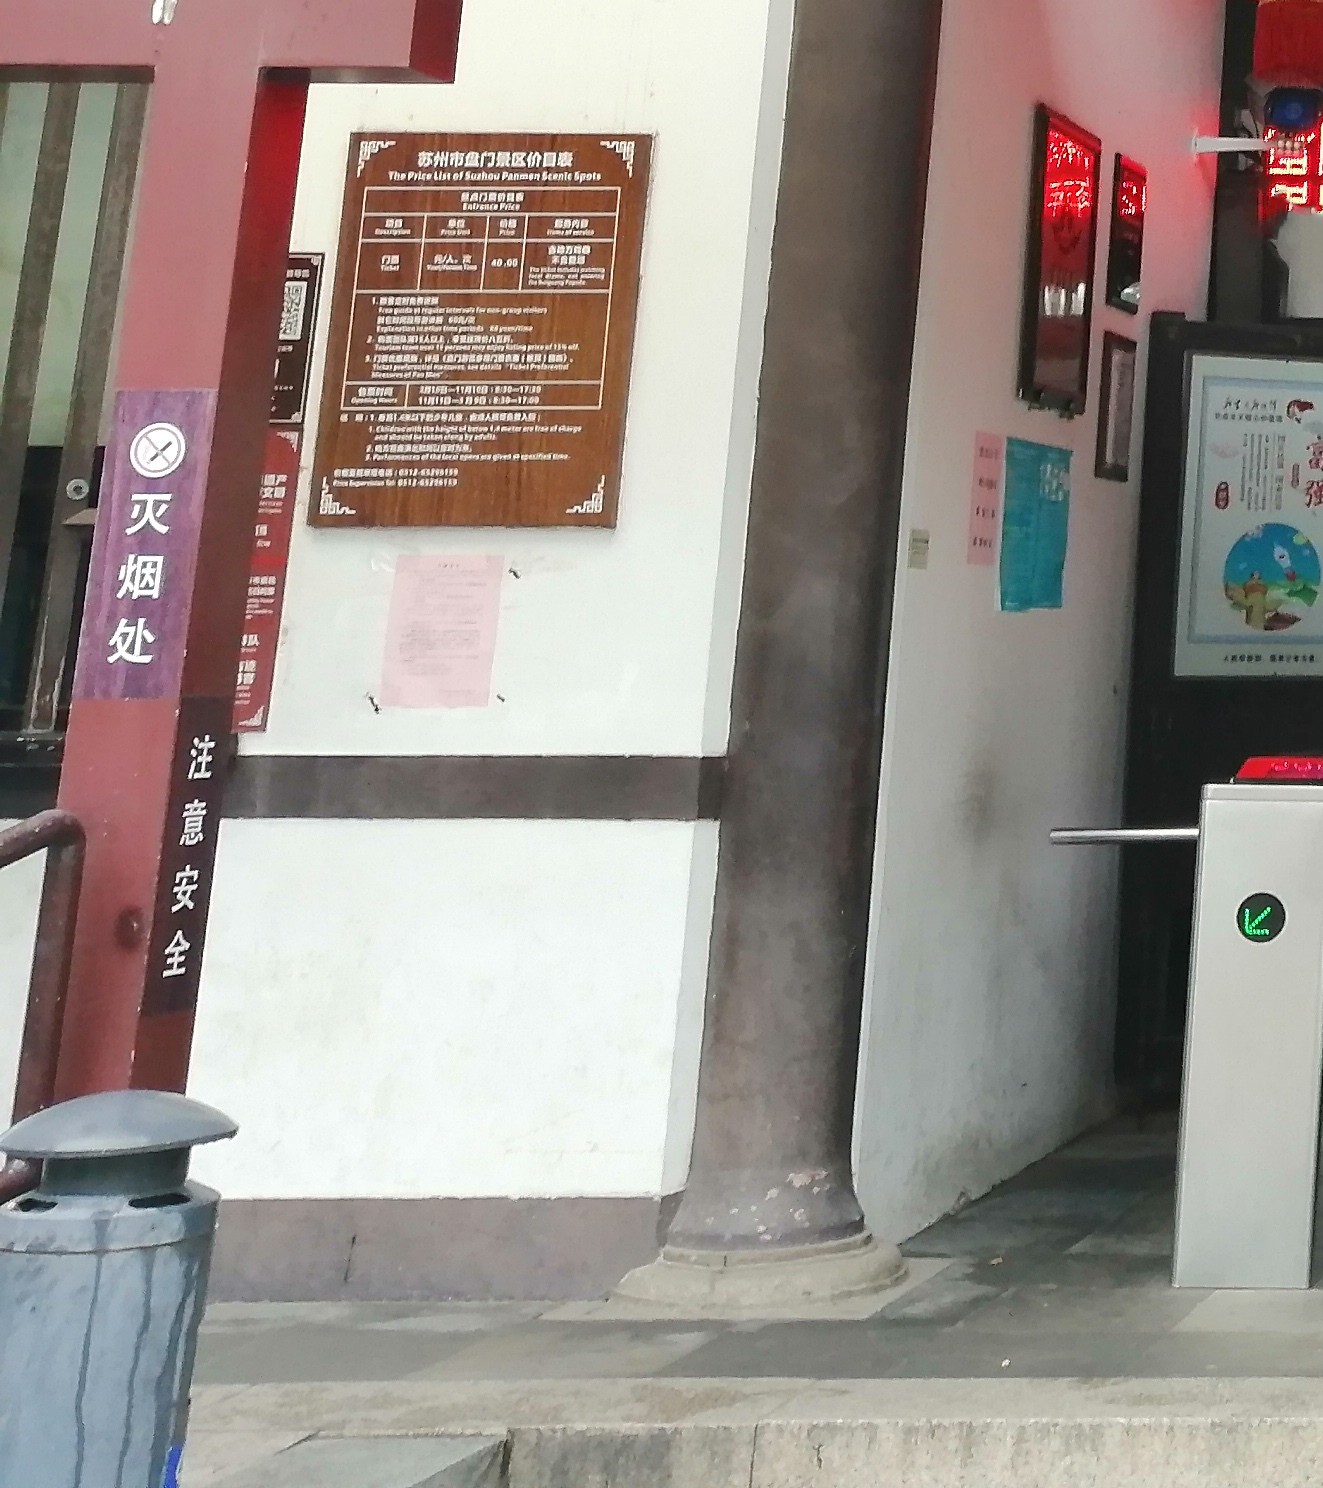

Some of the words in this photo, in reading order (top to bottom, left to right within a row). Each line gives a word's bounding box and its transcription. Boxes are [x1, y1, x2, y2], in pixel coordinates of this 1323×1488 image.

[108, 492, 173, 665] 灭烟处
[162, 733, 216, 979] 注意安全
